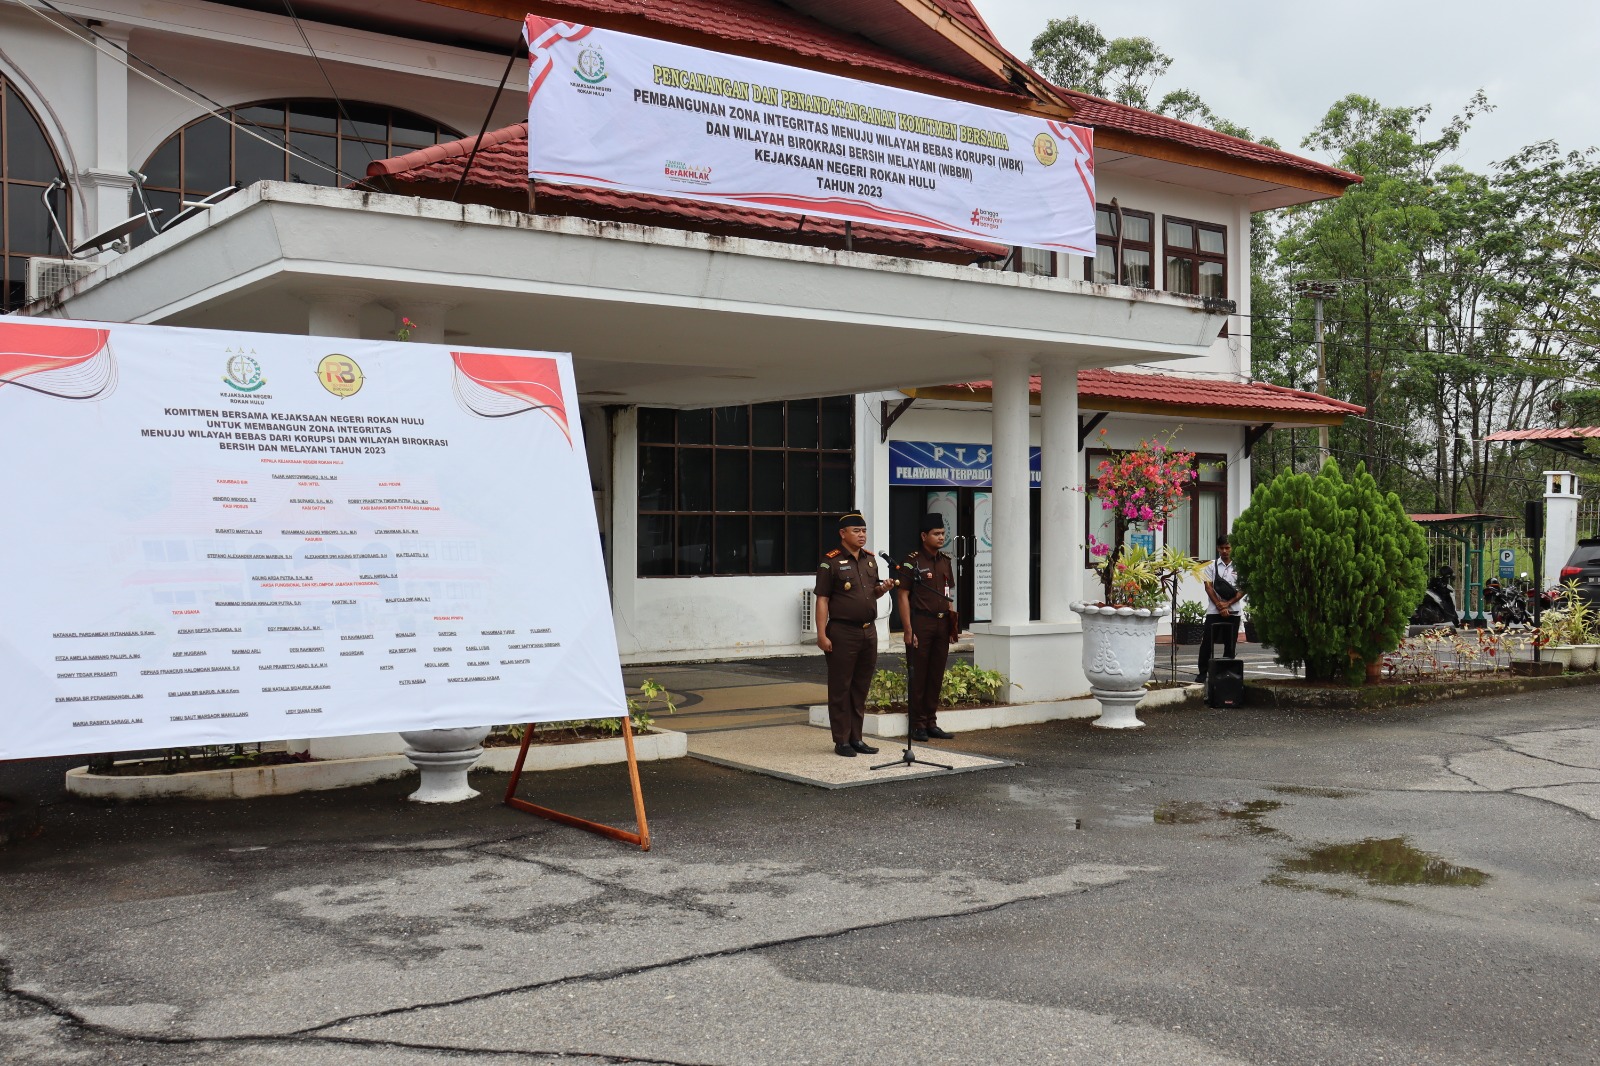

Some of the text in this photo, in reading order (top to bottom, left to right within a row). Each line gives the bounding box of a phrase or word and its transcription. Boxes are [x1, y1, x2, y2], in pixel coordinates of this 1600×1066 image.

[653, 65, 1009, 151] PENCANANGAN DAN PENANDATANGANAN KOMITMEN BERSAMA
[634, 89, 1024, 175] PEMBANGUNAN ZONA INTEGRITAS MENUJU WILAYAH BEBAS KORUPSI (WBK)
[706, 122, 973, 183] DAN WILAYAH BIROKRASI BERSIH MELAYANI (WBBM)
[665, 168, 709, 180] BerAKHLAK
[755, 149, 936, 190] KEJAKSAAN NEGERI ROKAN HULU
[817, 177, 883, 198] TAHUN 2023
[164, 408, 219, 417] KOMITMEN
[222, 410, 268, 419] BERSAMA
[271, 413, 326, 422] KEJAKSAAN
[401, 417, 424, 425] HULU
[207, 420, 241, 429] UNTUK
[244, 422, 306, 432] MEMBANGUN
[337, 425, 392, 433] INTEGRITAS
[141, 429, 185, 437] MENUJU
[187, 430, 232, 439] WILAYAH
[235, 432, 266, 441] BEBAS
[269, 434, 292, 442] DARI
[294, 435, 335, 443] KORUPSI
[359, 436, 399, 444] WILAYAH
[402, 437, 448, 446] BIROKRASI
[219, 443, 256, 451] BERSIH
[259, 443, 278, 452] DAN
[281, 444, 327, 453] MELAYANI
[365, 446, 385, 454] 2023
[934, 446, 987, 463] P T S
[896, 467, 949, 479] PELAYANAN
[951, 469, 990, 480] TERPADU
